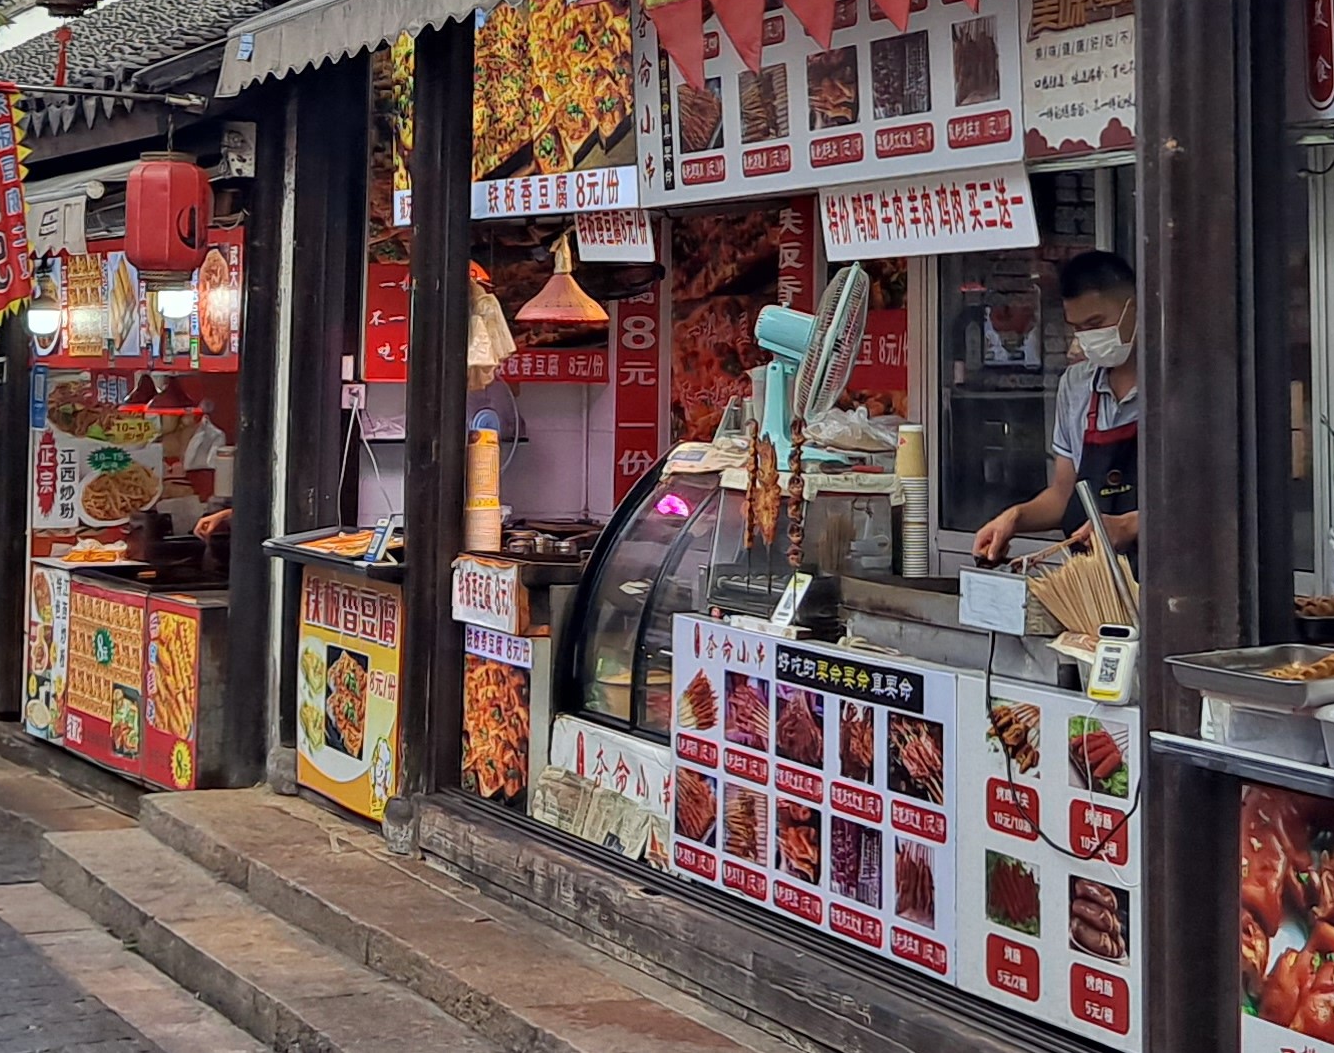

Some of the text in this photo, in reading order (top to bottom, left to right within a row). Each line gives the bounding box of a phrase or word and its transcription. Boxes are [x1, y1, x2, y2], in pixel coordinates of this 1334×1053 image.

[487, 168, 620, 213] 铁板香豆腐 8元/份
[568, 356, 605, 377] 8元/份
[59, 448, 77, 519] 江西炒粉
[303, 575, 399, 647] 铁板香豆腐
[705, 630, 767, 670] 夺命小串
[369, 670, 396, 701] 8元/份
[777, 651, 915, 703] 好吃的要命要命真要命
